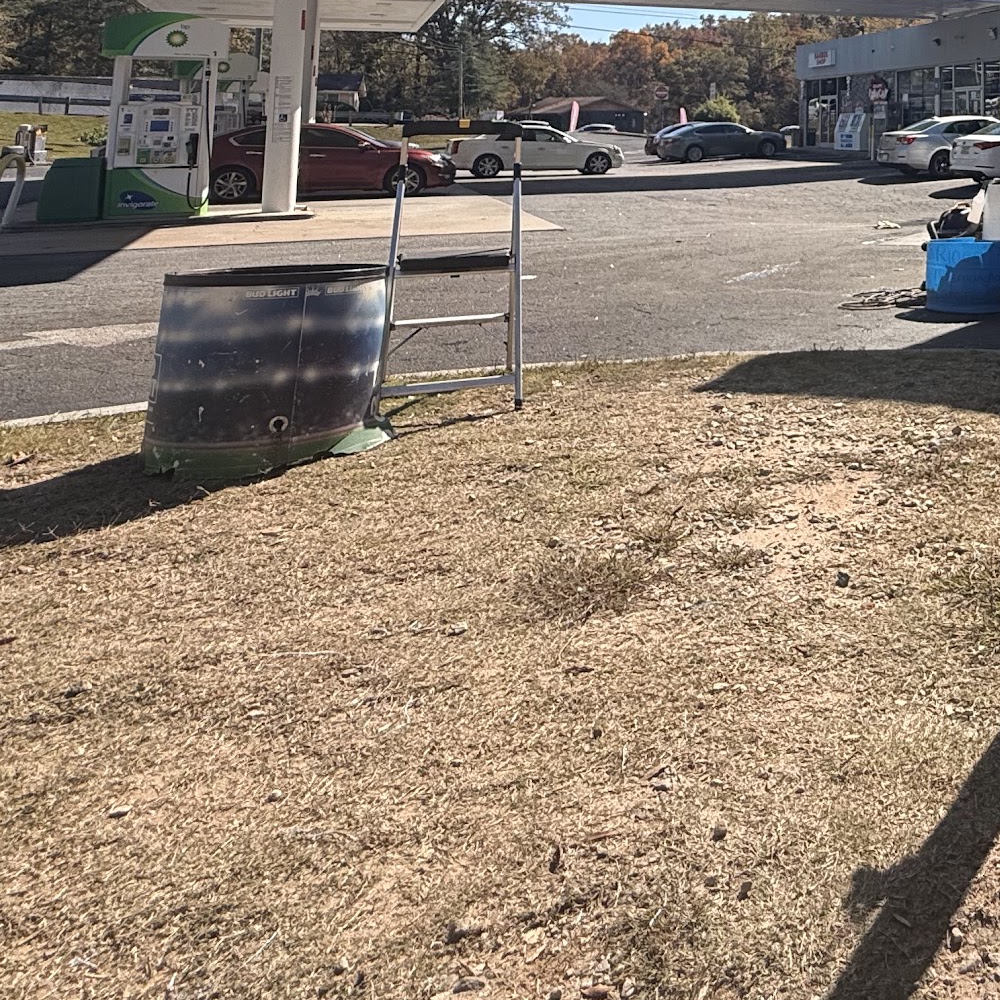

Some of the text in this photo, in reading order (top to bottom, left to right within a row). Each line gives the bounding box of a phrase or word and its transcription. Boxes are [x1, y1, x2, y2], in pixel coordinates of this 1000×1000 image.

[245, 289, 298, 298] BUD LIGHT
[326, 286, 345, 294] BUD
